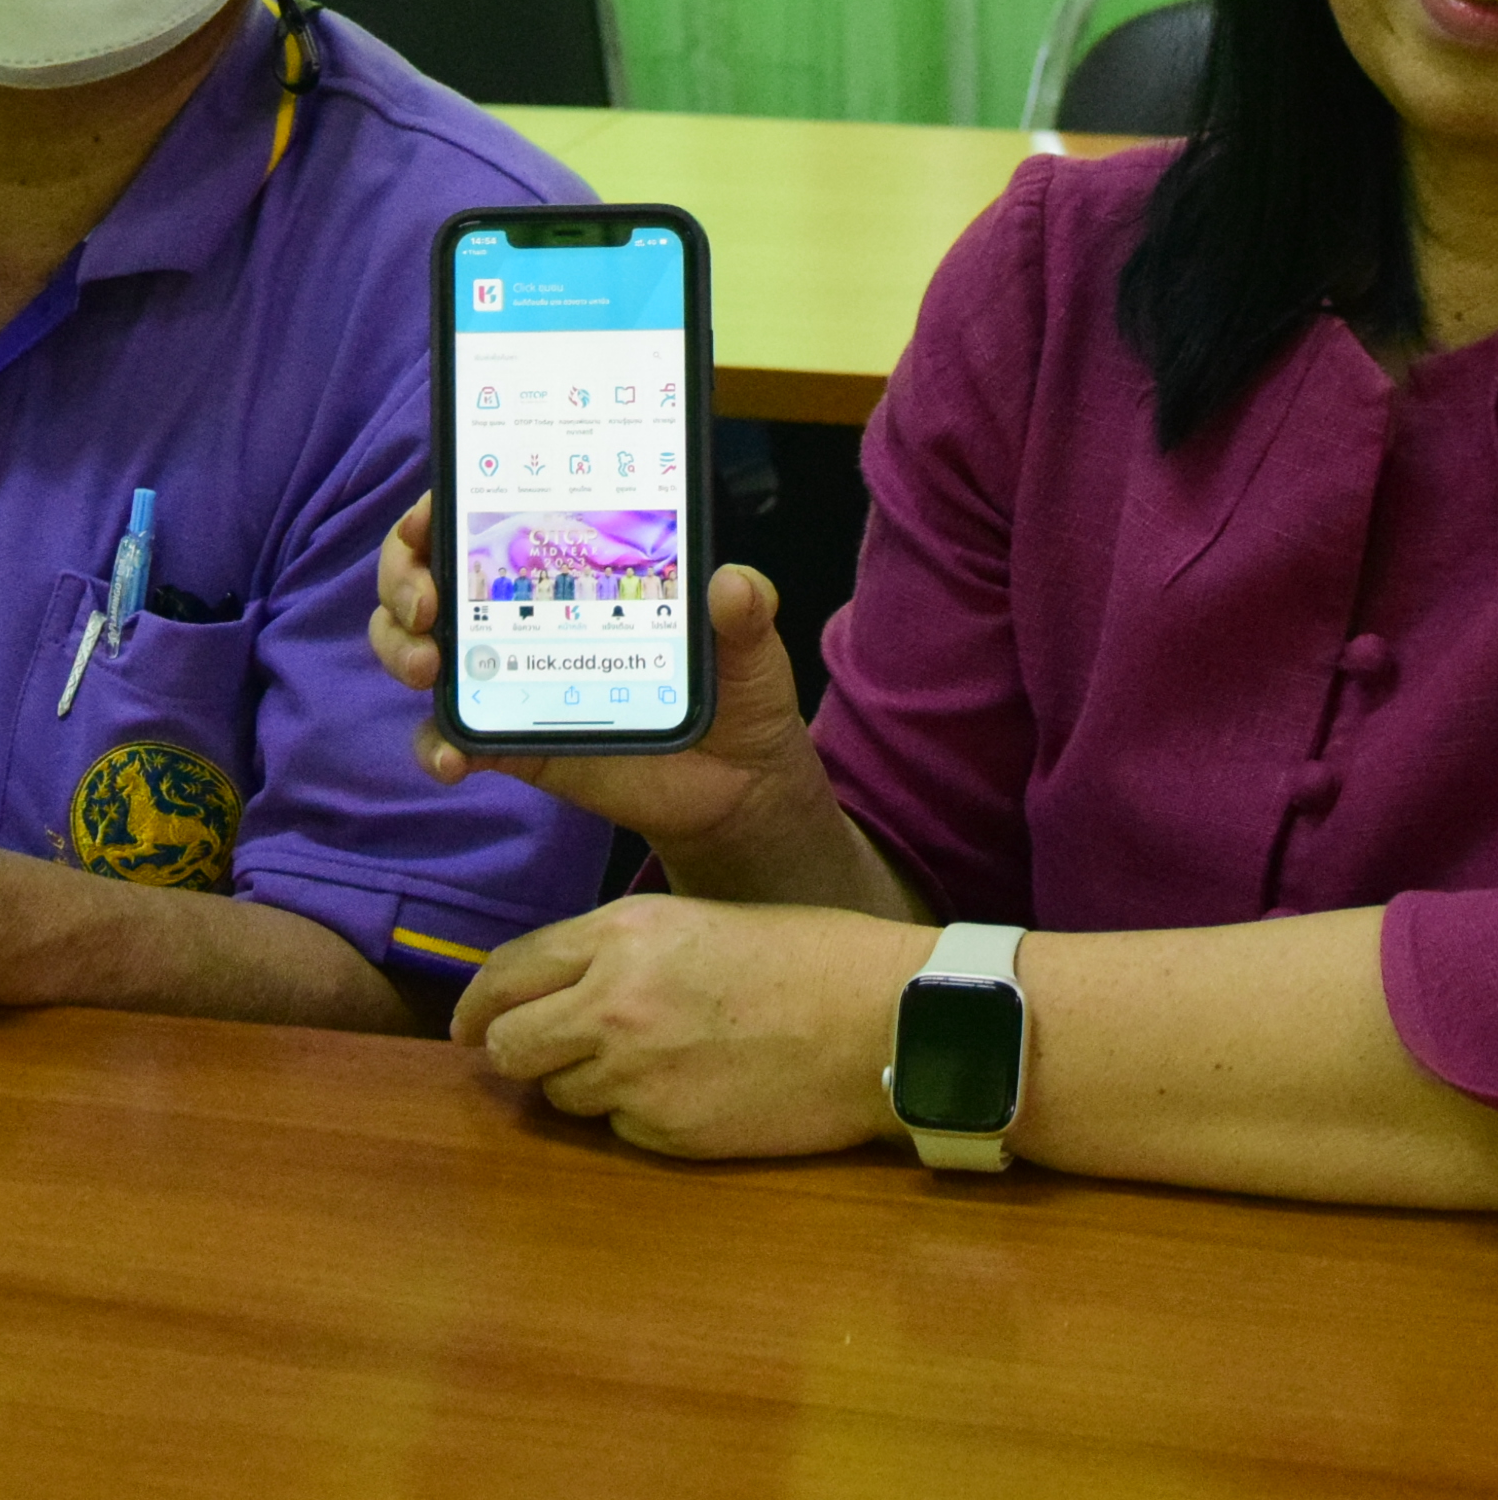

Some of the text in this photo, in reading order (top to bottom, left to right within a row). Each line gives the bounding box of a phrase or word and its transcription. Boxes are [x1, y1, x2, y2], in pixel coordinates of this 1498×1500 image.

[470, 237, 497, 246] 14:54
[513, 283, 536, 293] Click
[520, 391, 548, 399] OTOP
[514, 418, 554, 427] OTOP Today
[529, 528, 598, 546] OTOP
[526, 654, 646, 673] lick.cdd.go.th
